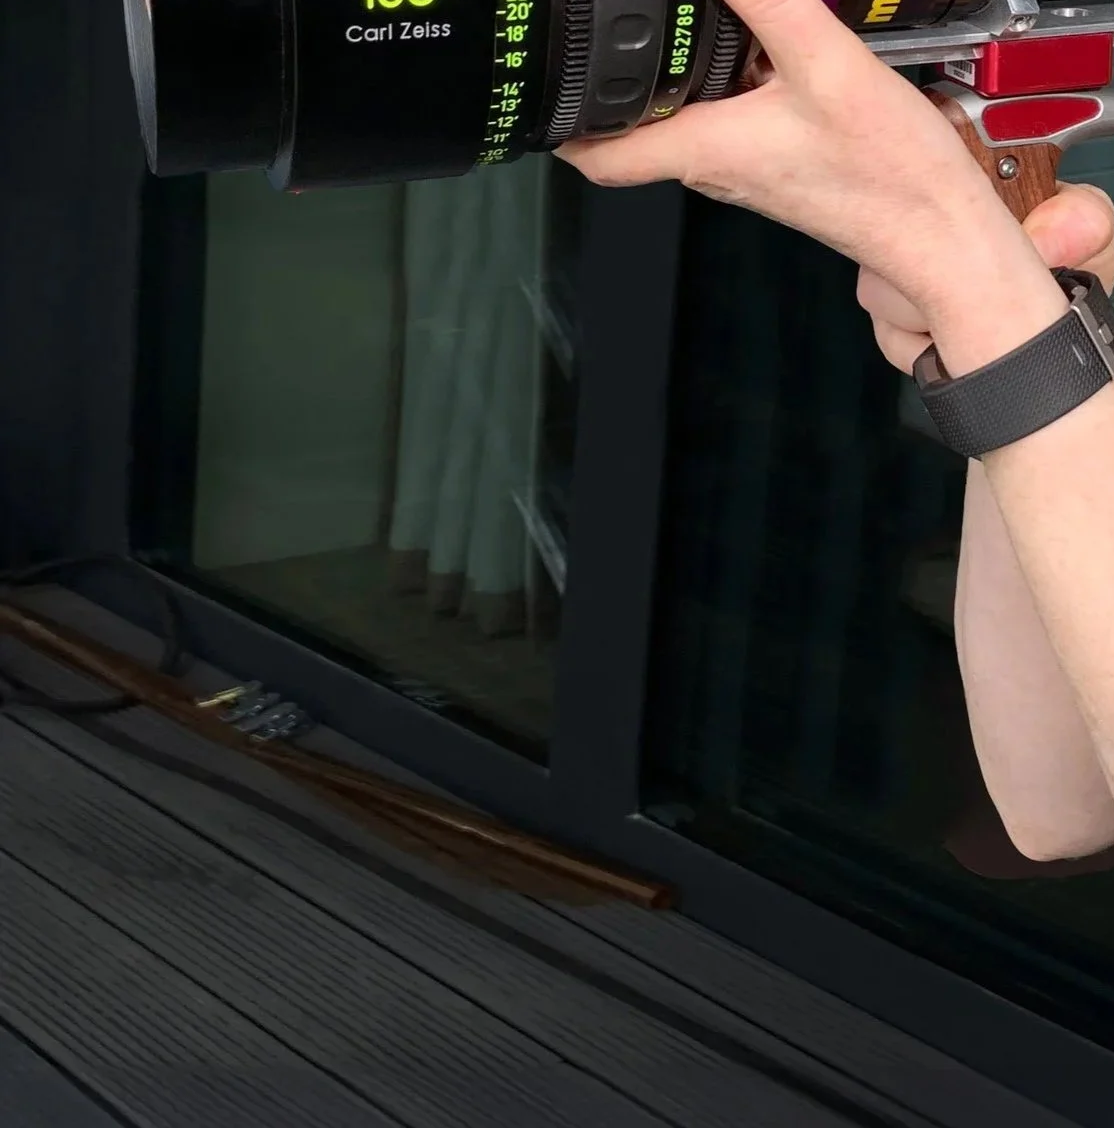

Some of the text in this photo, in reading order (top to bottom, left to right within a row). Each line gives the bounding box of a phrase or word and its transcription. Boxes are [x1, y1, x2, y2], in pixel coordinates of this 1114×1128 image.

[345, 21, 451, 42] Carl Zeiss
[669, 4, 695, 75] 8952789
